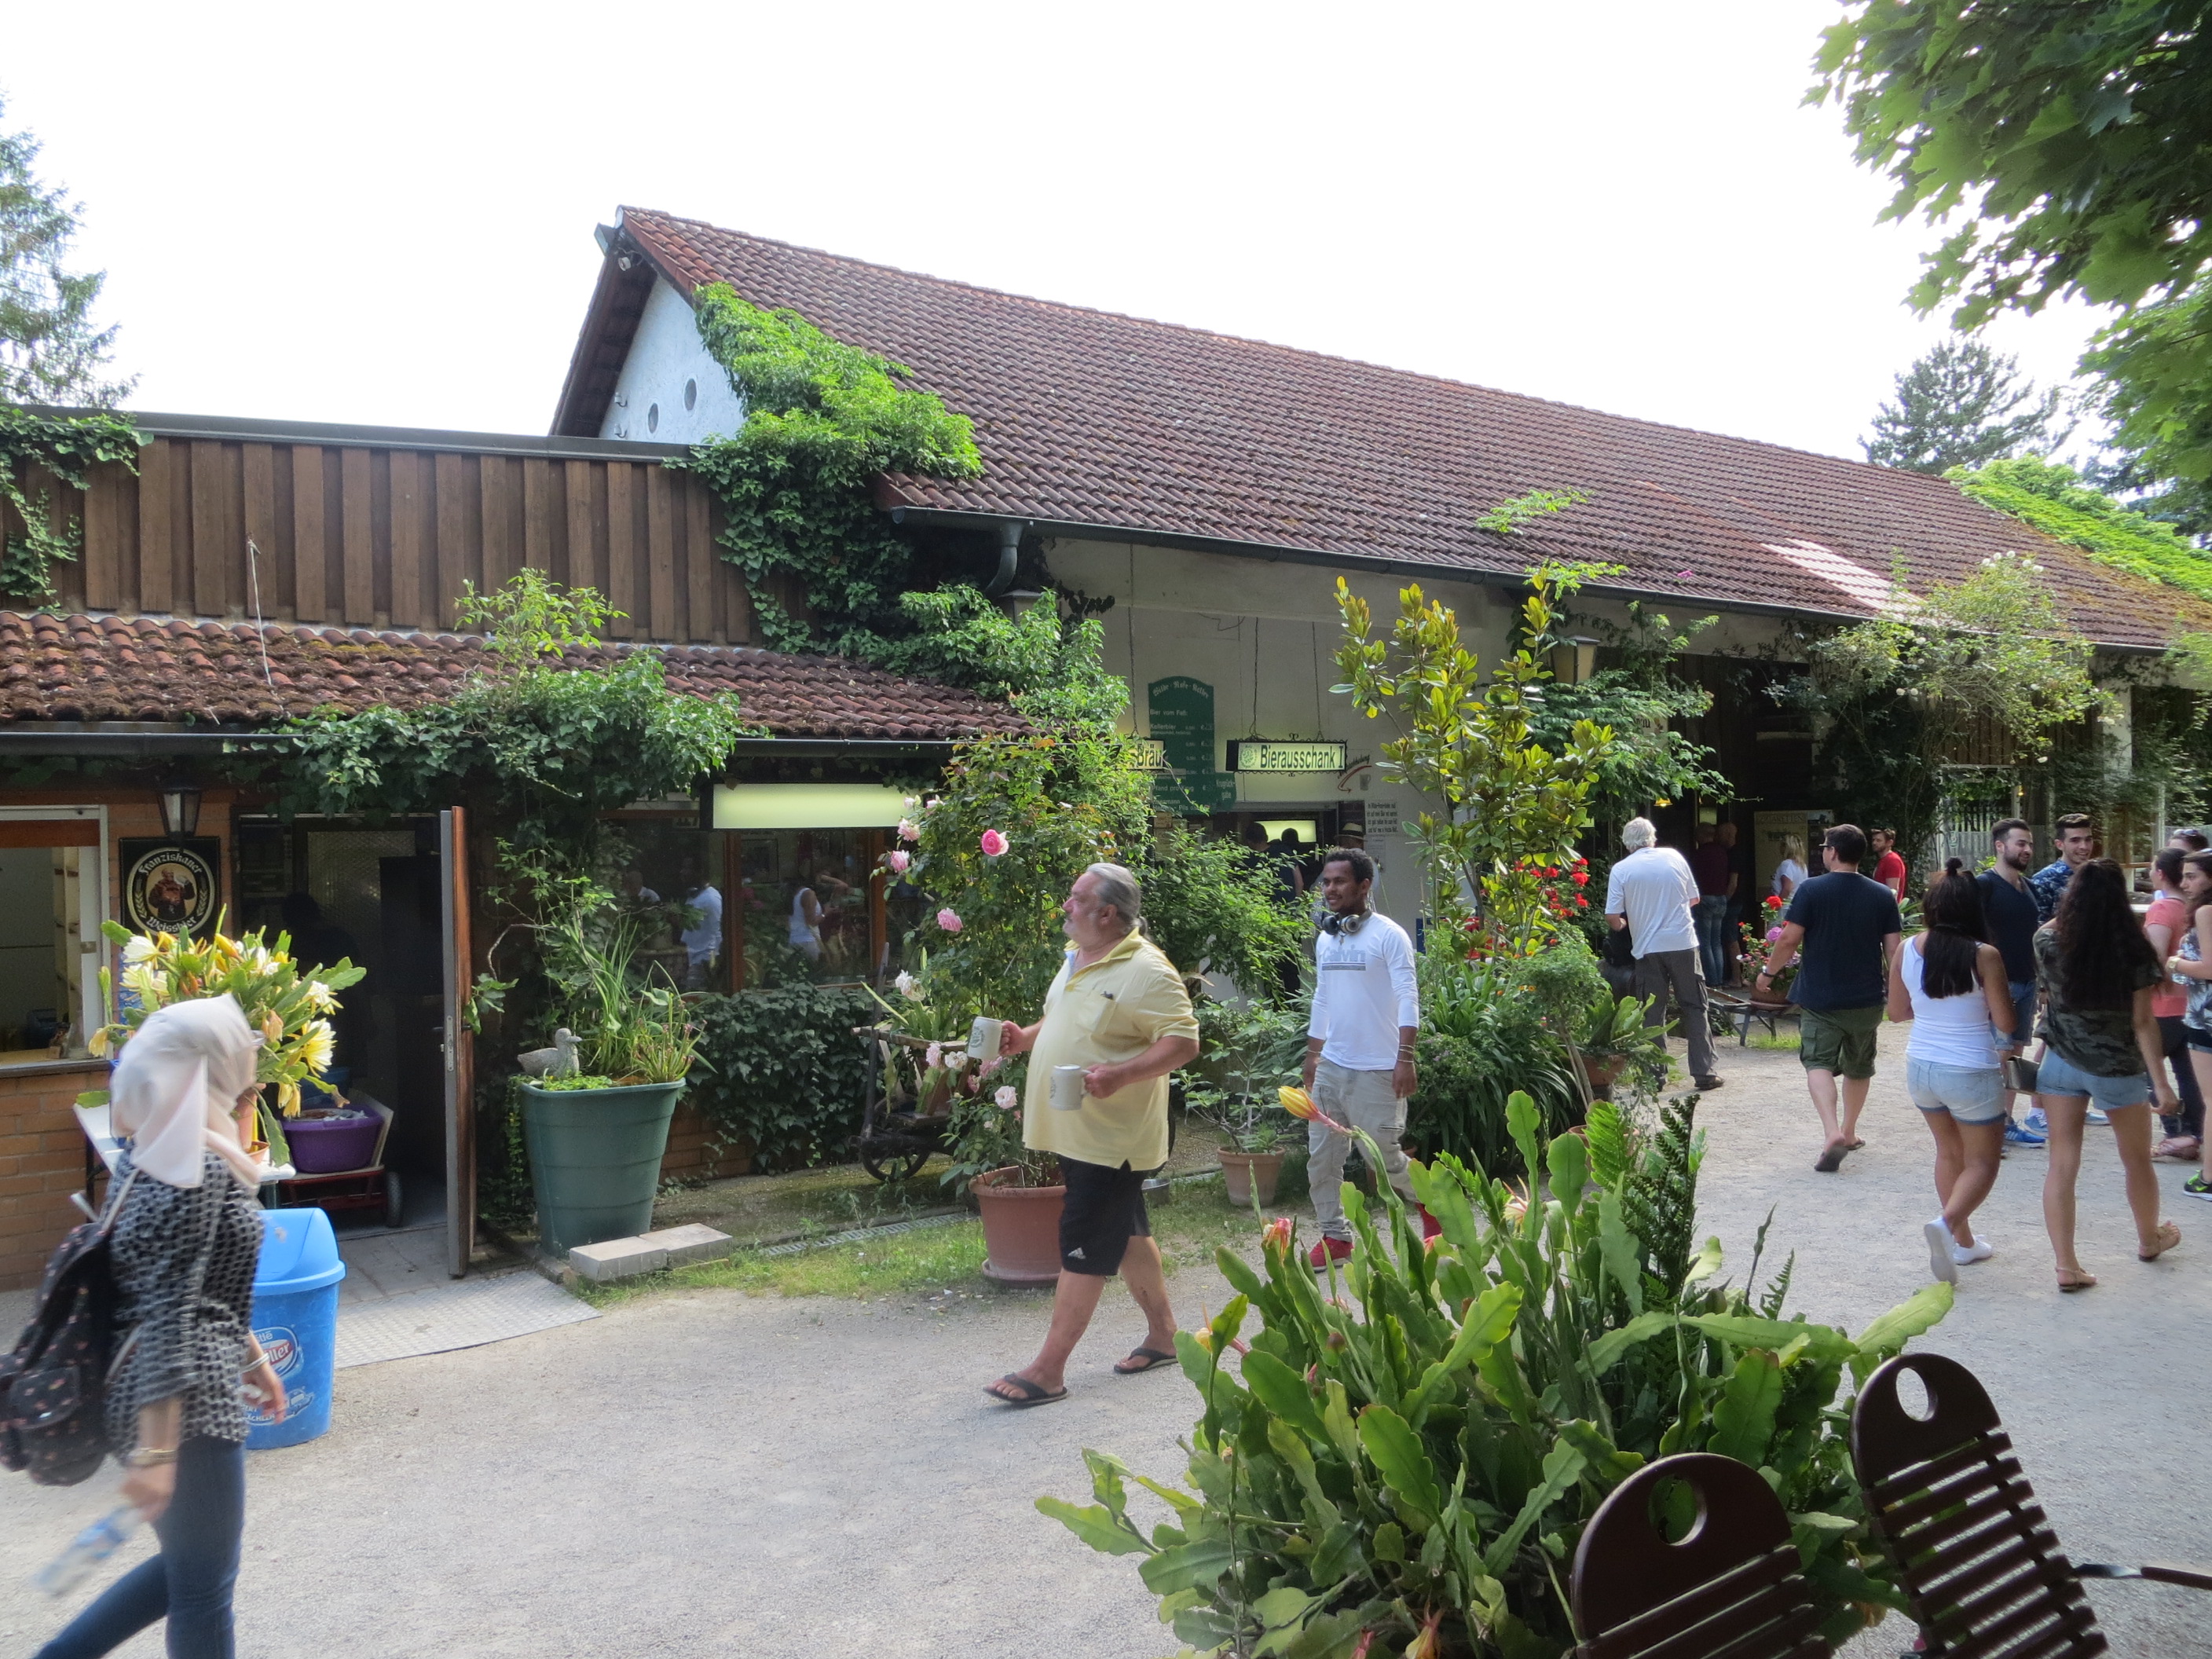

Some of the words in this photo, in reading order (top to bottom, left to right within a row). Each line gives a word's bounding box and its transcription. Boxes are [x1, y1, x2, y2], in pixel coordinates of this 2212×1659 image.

[1260, 744, 1336, 769] Bierausschank
[1338, 745, 1344, 769] I
[137, 852, 203, 876] Franziskaner
[146, 916, 197, 933] Weissbier
